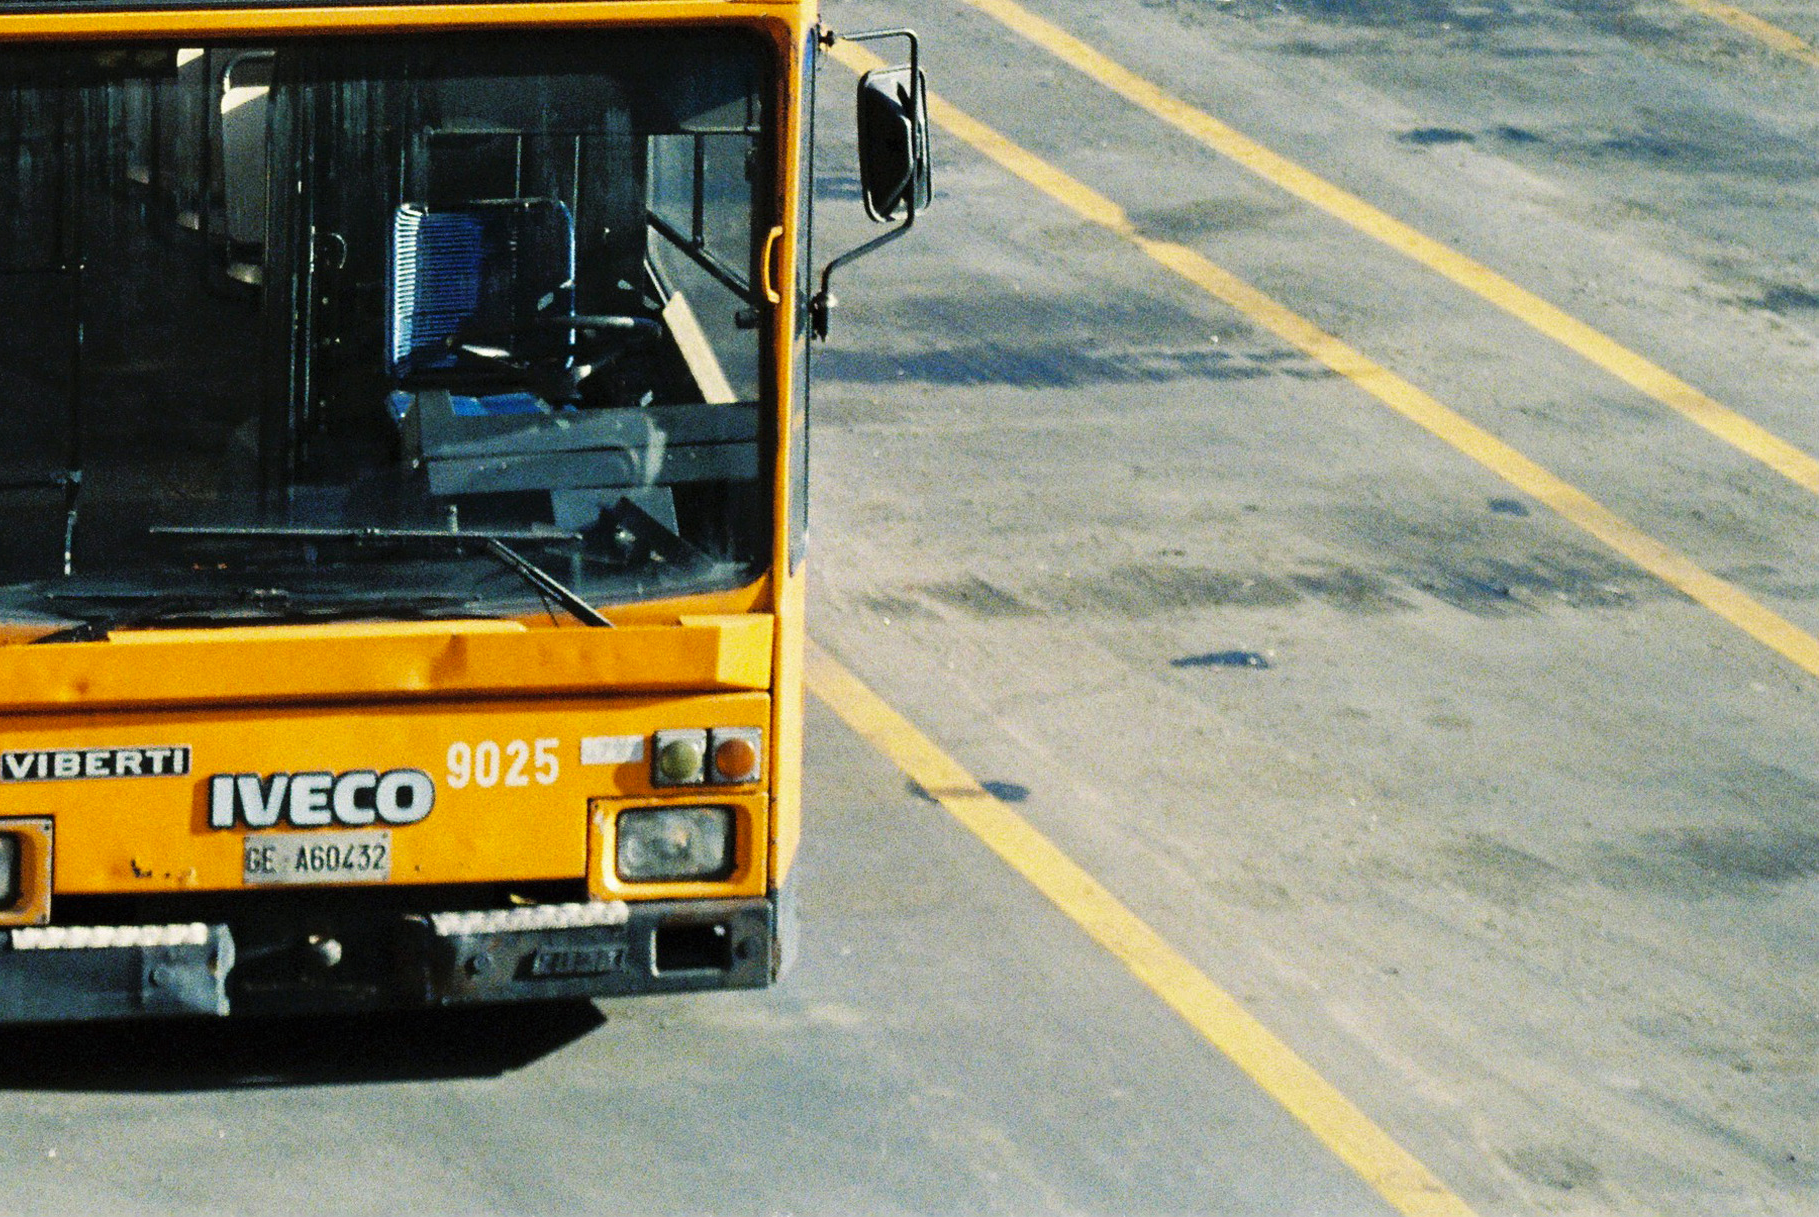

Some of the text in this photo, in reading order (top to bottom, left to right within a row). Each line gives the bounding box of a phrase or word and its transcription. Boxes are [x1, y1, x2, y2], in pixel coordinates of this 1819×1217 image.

[5, 748, 183, 779] VIBERTI
[446, 738, 559, 788] 9025
[209, 768, 436, 828] IVECO
[245, 843, 386, 874] GE A60432
